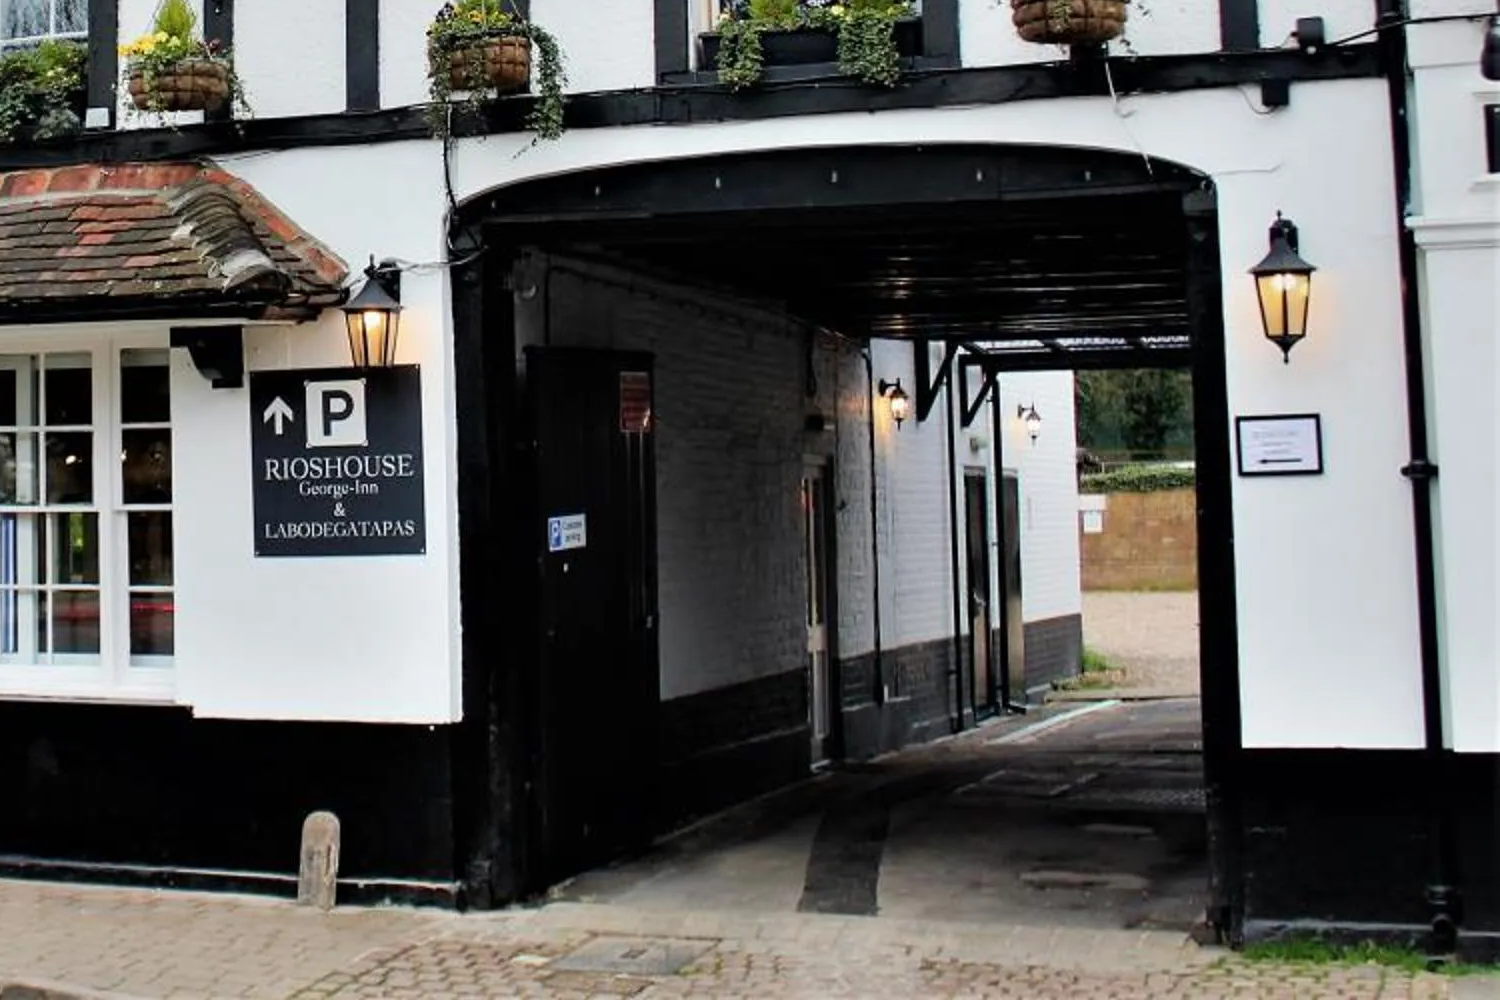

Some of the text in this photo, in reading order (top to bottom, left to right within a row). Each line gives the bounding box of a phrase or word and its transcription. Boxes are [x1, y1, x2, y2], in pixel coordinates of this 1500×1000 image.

[322, 389, 355, 437] P
[264, 453, 415, 481] RIOSHOUSE
[299, 479, 379, 499] George-Inn
[333, 501, 346, 517] &
[264, 520, 416, 539] LABODEGATAPAS
